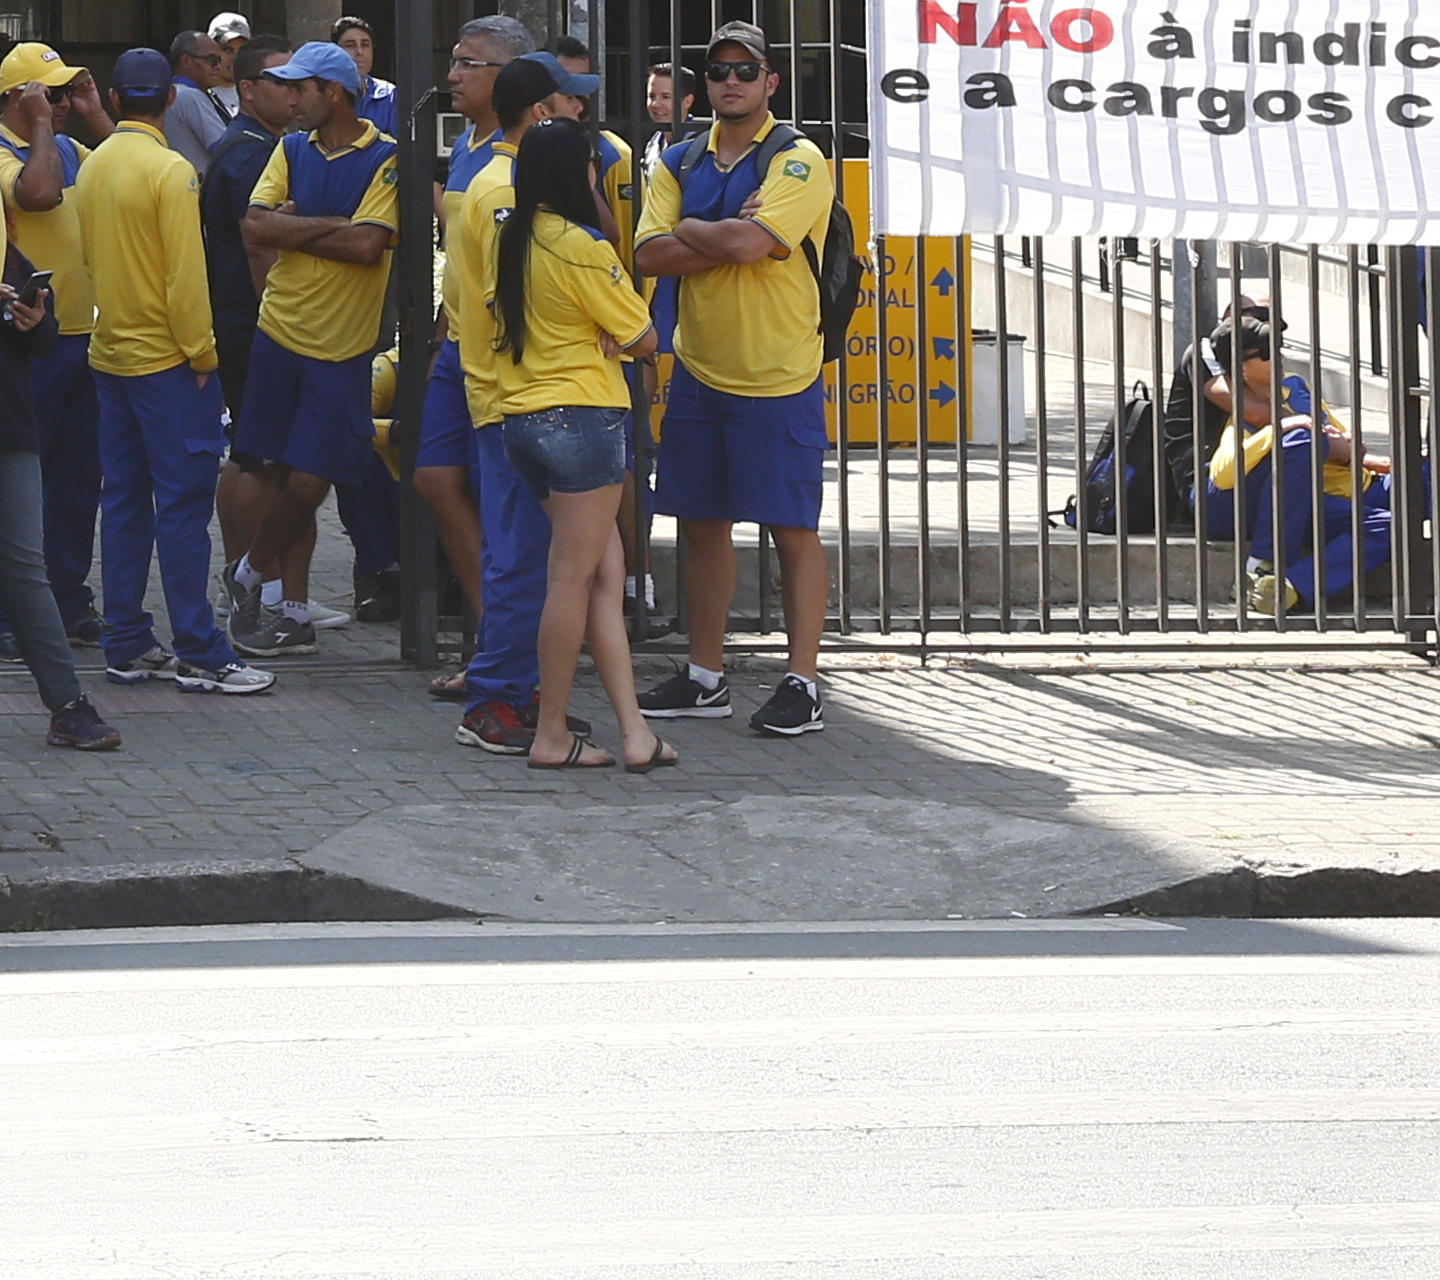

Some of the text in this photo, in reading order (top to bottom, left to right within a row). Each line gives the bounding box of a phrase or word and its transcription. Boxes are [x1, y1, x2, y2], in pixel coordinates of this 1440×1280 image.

[1146, 11, 1196, 59] à
[880, 68, 931, 103] e
[963, 70, 1017, 110] a
[1047, 78, 1353, 136] cargos
